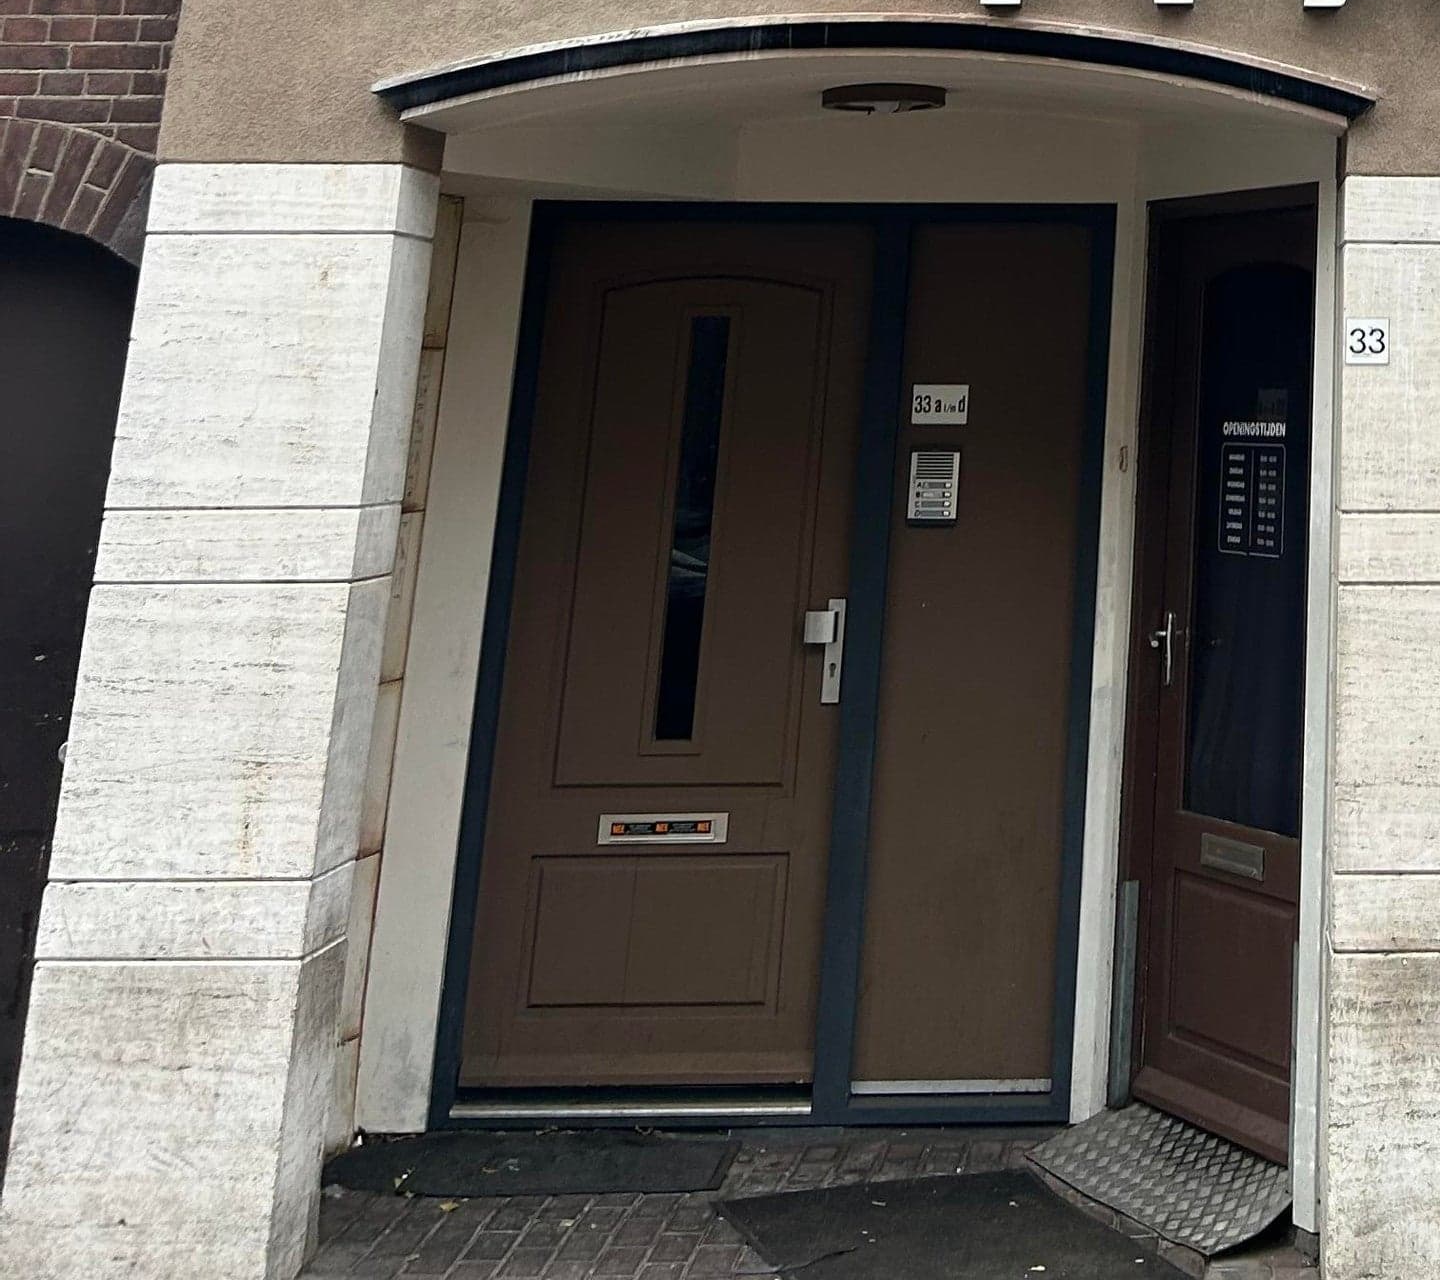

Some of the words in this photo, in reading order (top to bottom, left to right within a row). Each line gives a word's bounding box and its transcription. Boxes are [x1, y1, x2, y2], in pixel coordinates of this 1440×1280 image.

[1349, 327, 1386, 354] 33
[914, 395, 931, 413] 33
[934, 399, 942, 413] a
[958, 395, 966, 413] d
[1223, 421, 1286, 437] OPENINGSTIJDEN
